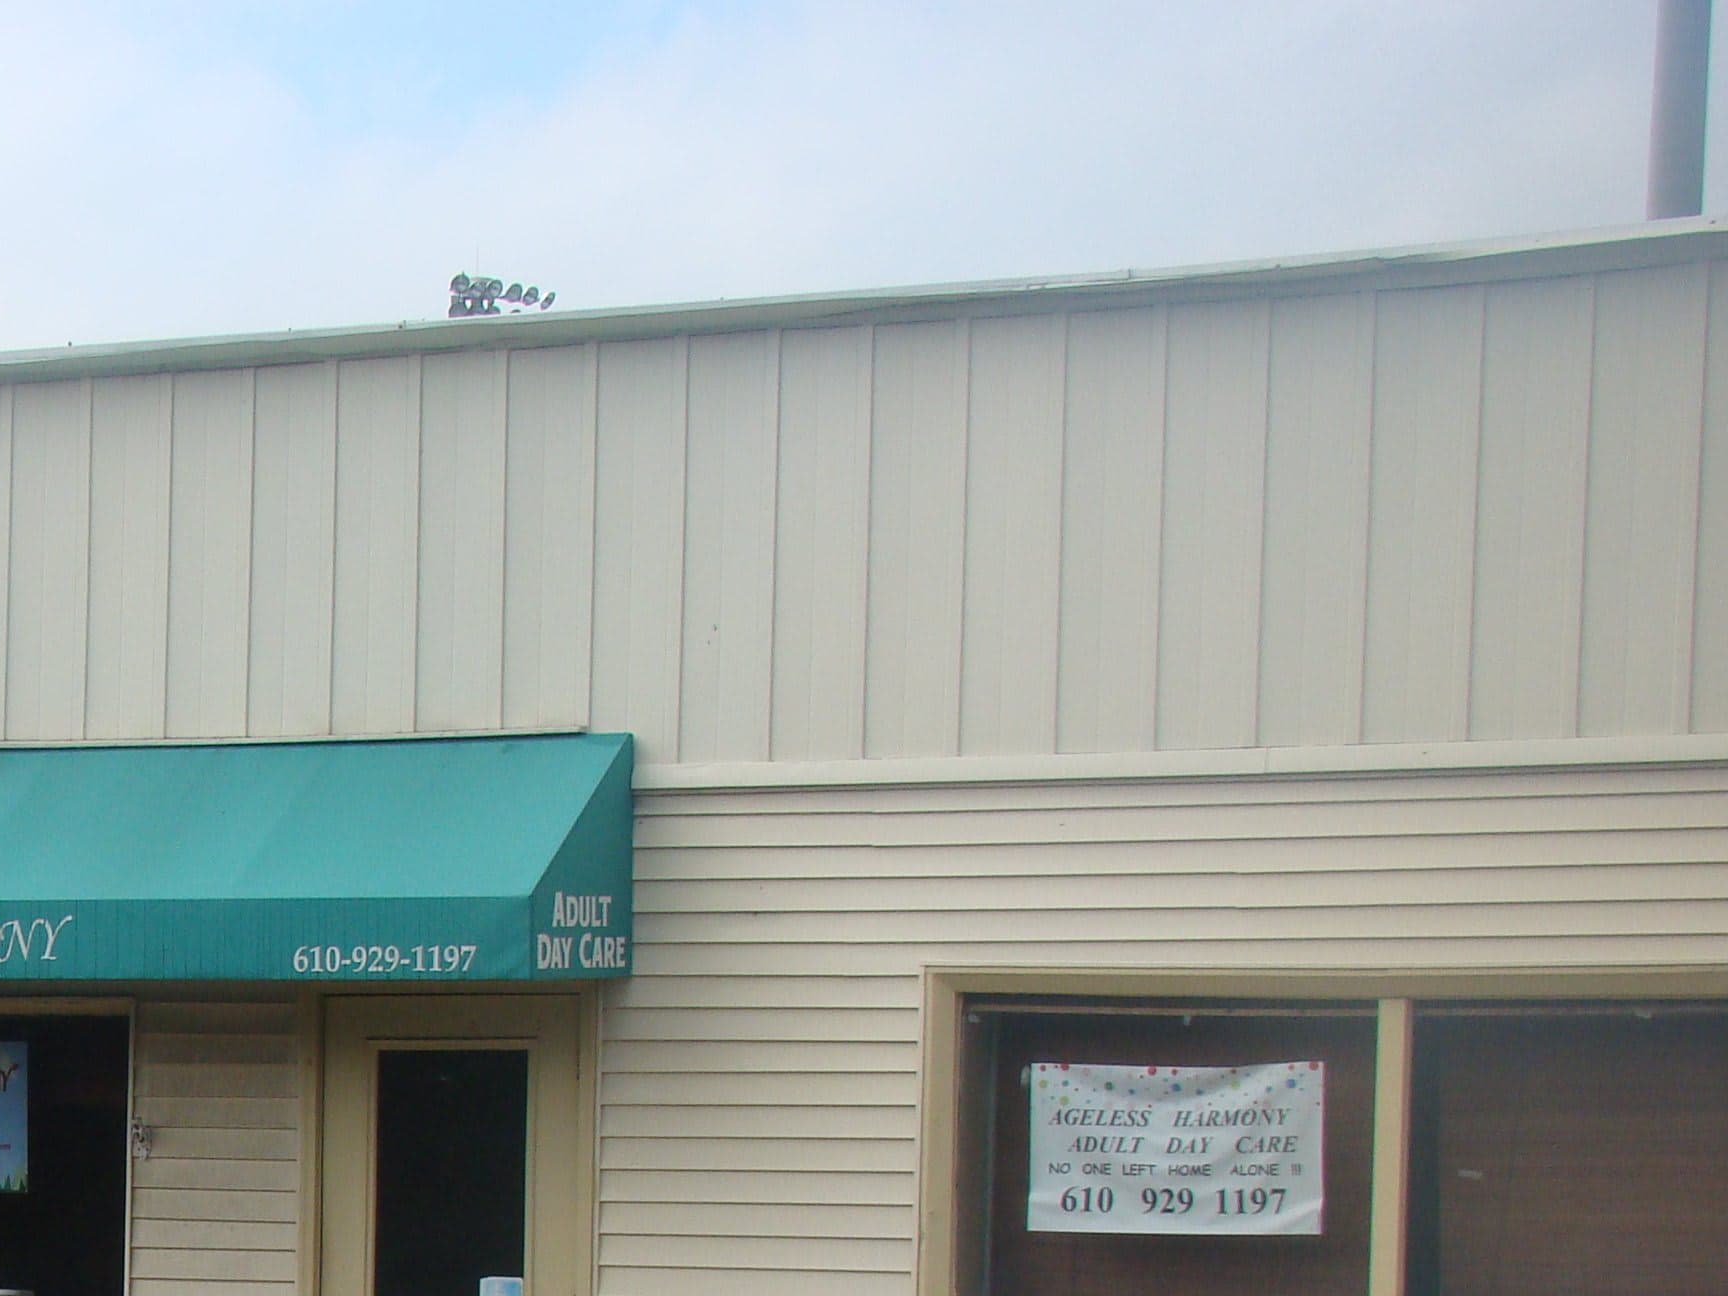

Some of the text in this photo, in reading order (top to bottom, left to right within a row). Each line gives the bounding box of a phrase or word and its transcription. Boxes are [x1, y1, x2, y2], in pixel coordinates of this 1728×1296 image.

[551, 891, 613, 928] ADULT
[292, 944, 477, 973] 610-929-1197
[536, 932, 627, 970] DAY CARE
[1048, 1107, 1291, 1128] AGELESS HARMONY
[1067, 1135, 1299, 1155] ADULT DAY CARE
[1048, 1162, 1072, 1175] NO
[1082, 1162, 1112, 1176] ONE
[1122, 1163, 1157, 1176] LEFT
[1168, 1163, 1212, 1177] HOME
[1229, 1163, 1280, 1177] ALONE
[1060, 1186, 1288, 1216] 610 929 1197
